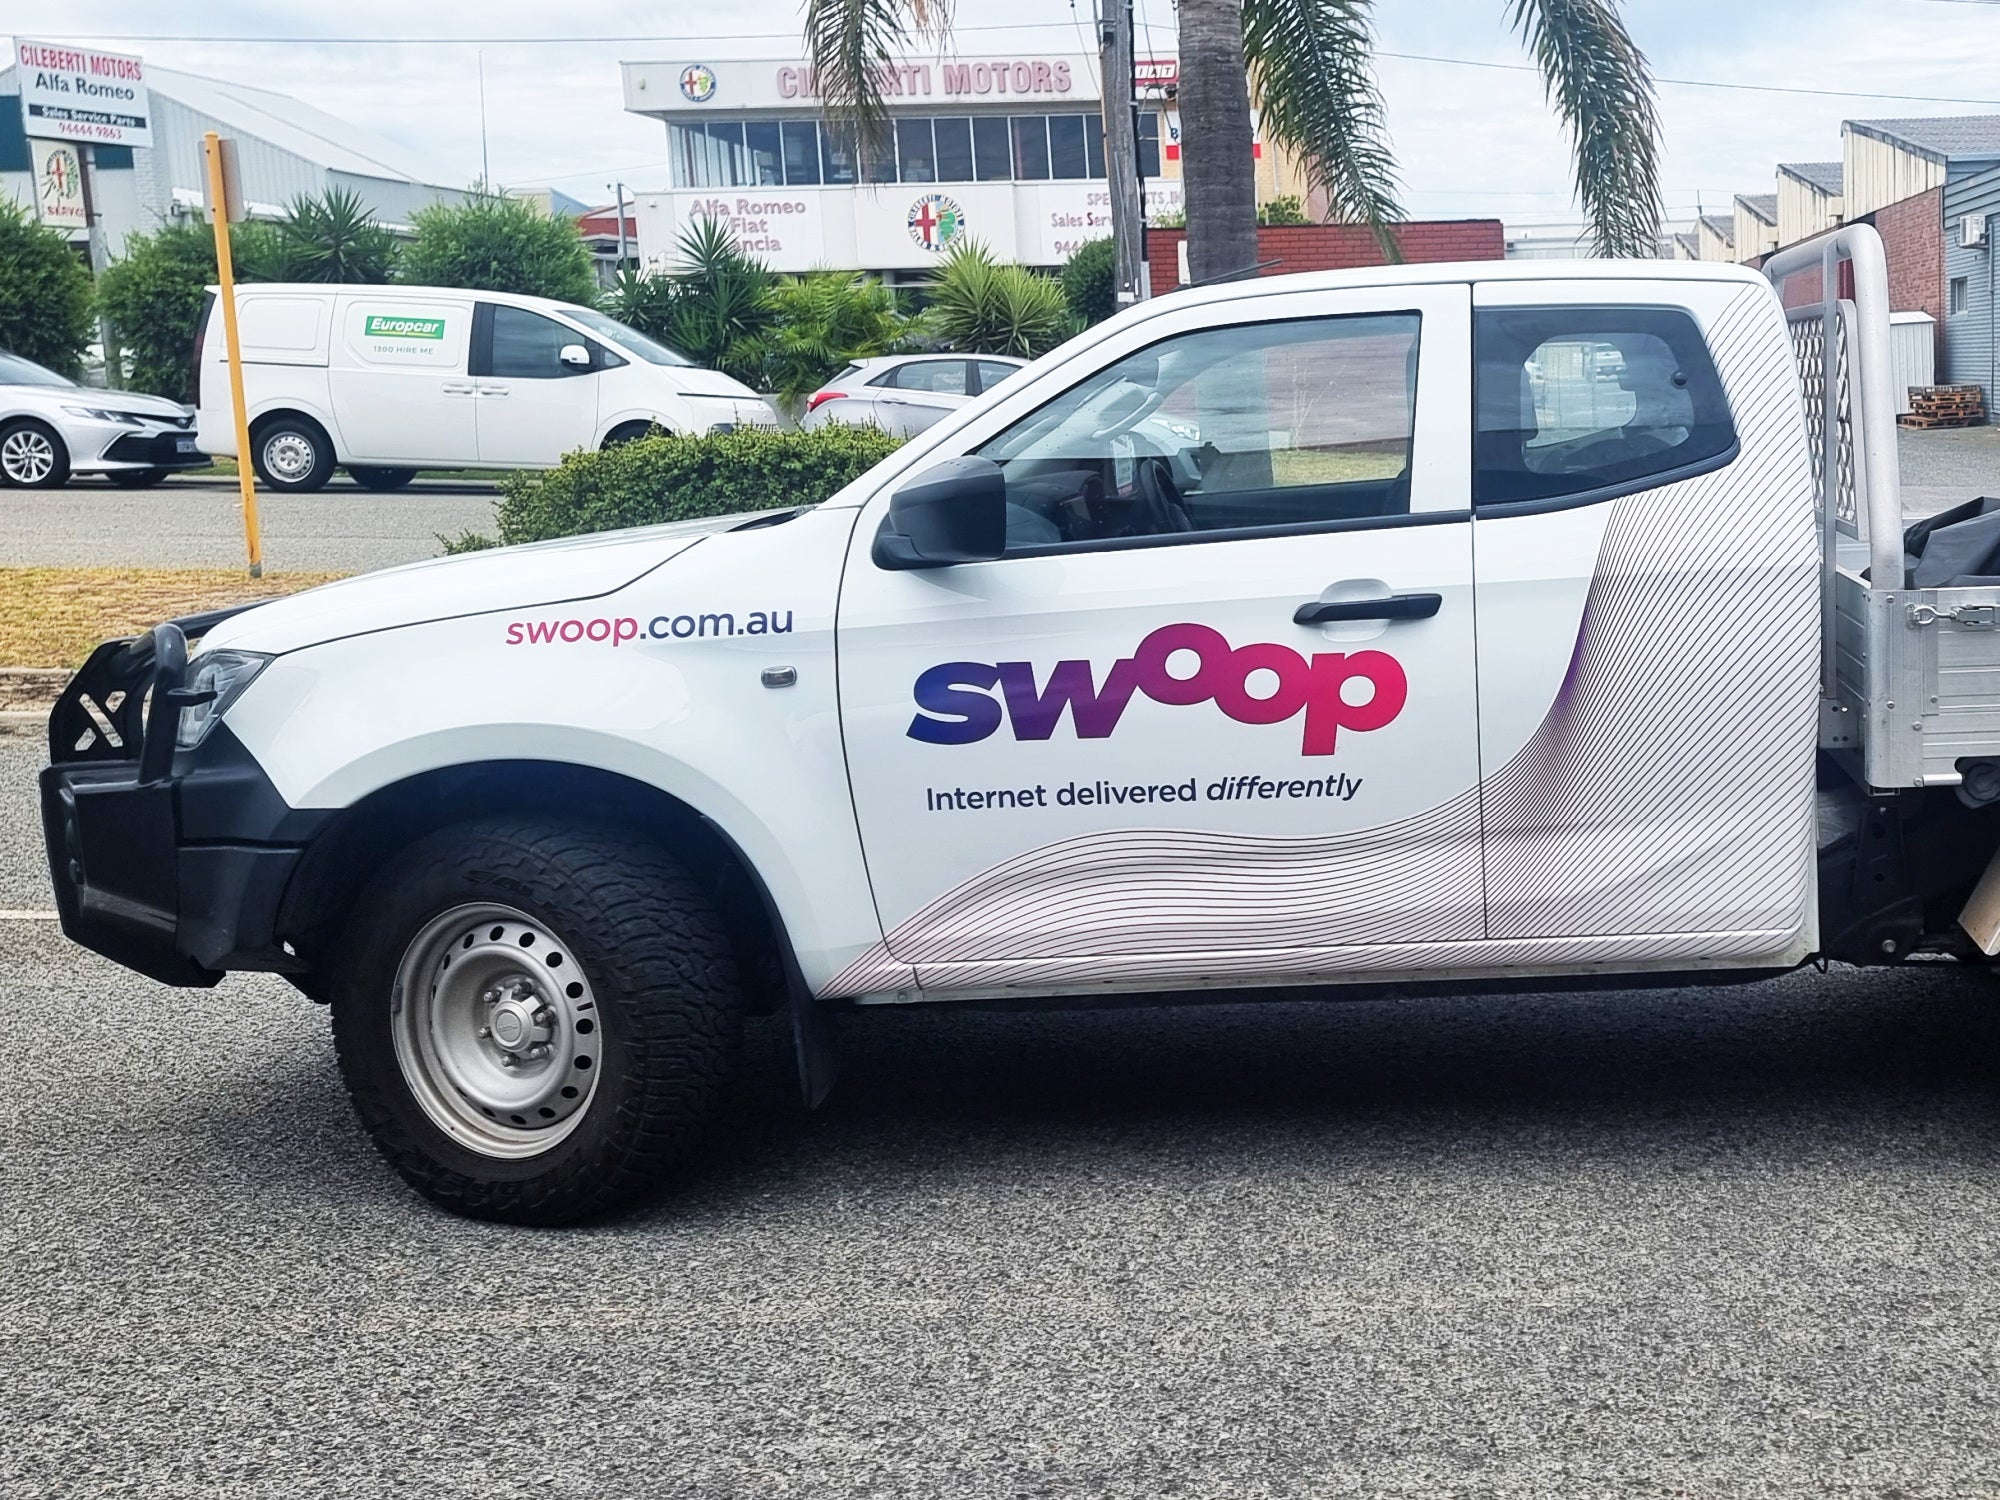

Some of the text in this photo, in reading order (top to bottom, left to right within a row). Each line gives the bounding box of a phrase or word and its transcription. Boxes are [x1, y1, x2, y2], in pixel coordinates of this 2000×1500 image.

[20, 45, 142, 81] CILEBERTI MOTORS
[1136, 64, 1176, 79] IAT
[35, 72, 135, 100] Alfa Romeo
[943, 61, 1072, 95] MOTORS
[41, 105, 136, 128] Sales Service Parts
[689, 198, 806, 216] Alfa Romeo
[730, 217, 768, 233] Fiat
[1051, 213, 1083, 227] Sales
[732, 235, 782, 251] ancia
[370, 317, 440, 336] Europcar
[373, 345, 434, 355] 1300 HIRE ME
[506, 610, 793, 647] swoop.com.au
[906, 622, 1408, 757] swoop
[927, 772, 1363, 811] Internet delivered differently
